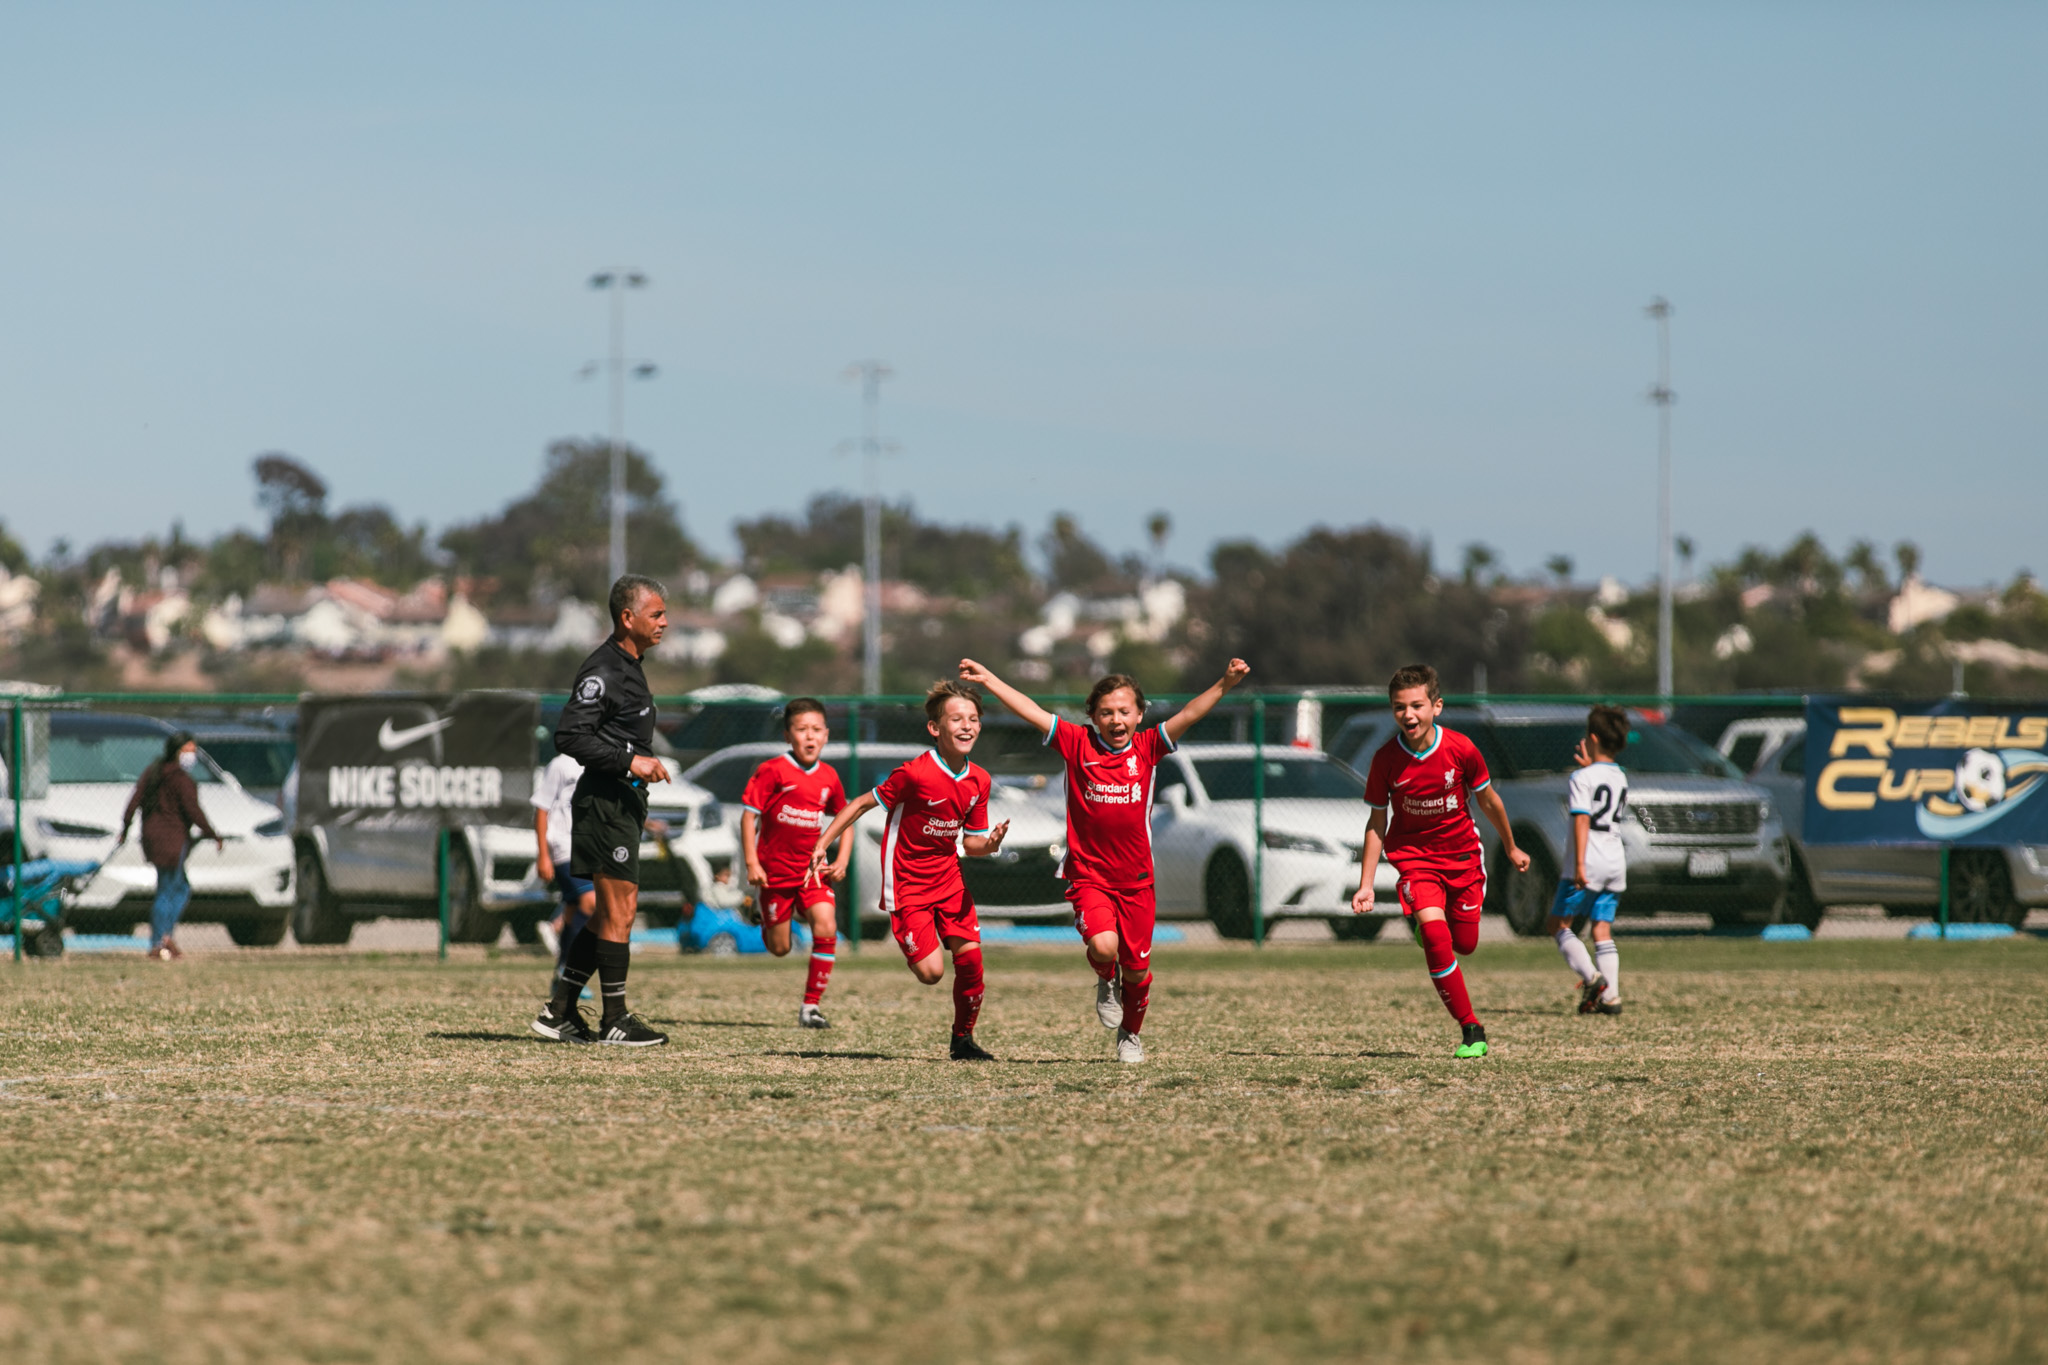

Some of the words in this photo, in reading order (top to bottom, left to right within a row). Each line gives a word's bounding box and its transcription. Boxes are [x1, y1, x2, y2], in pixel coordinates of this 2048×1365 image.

[1829, 707, 2048, 758] REBELS
[329, 766, 396, 808] NIKE
[400, 766, 503, 808] SOCCER
[1087, 780, 1130, 794] Standard
[1816, 759, 1955, 810] CUP
[1084, 790, 1130, 804] Chartered
[1403, 795, 1444, 808] Standard
[1402, 803, 1445, 816] Chartered
